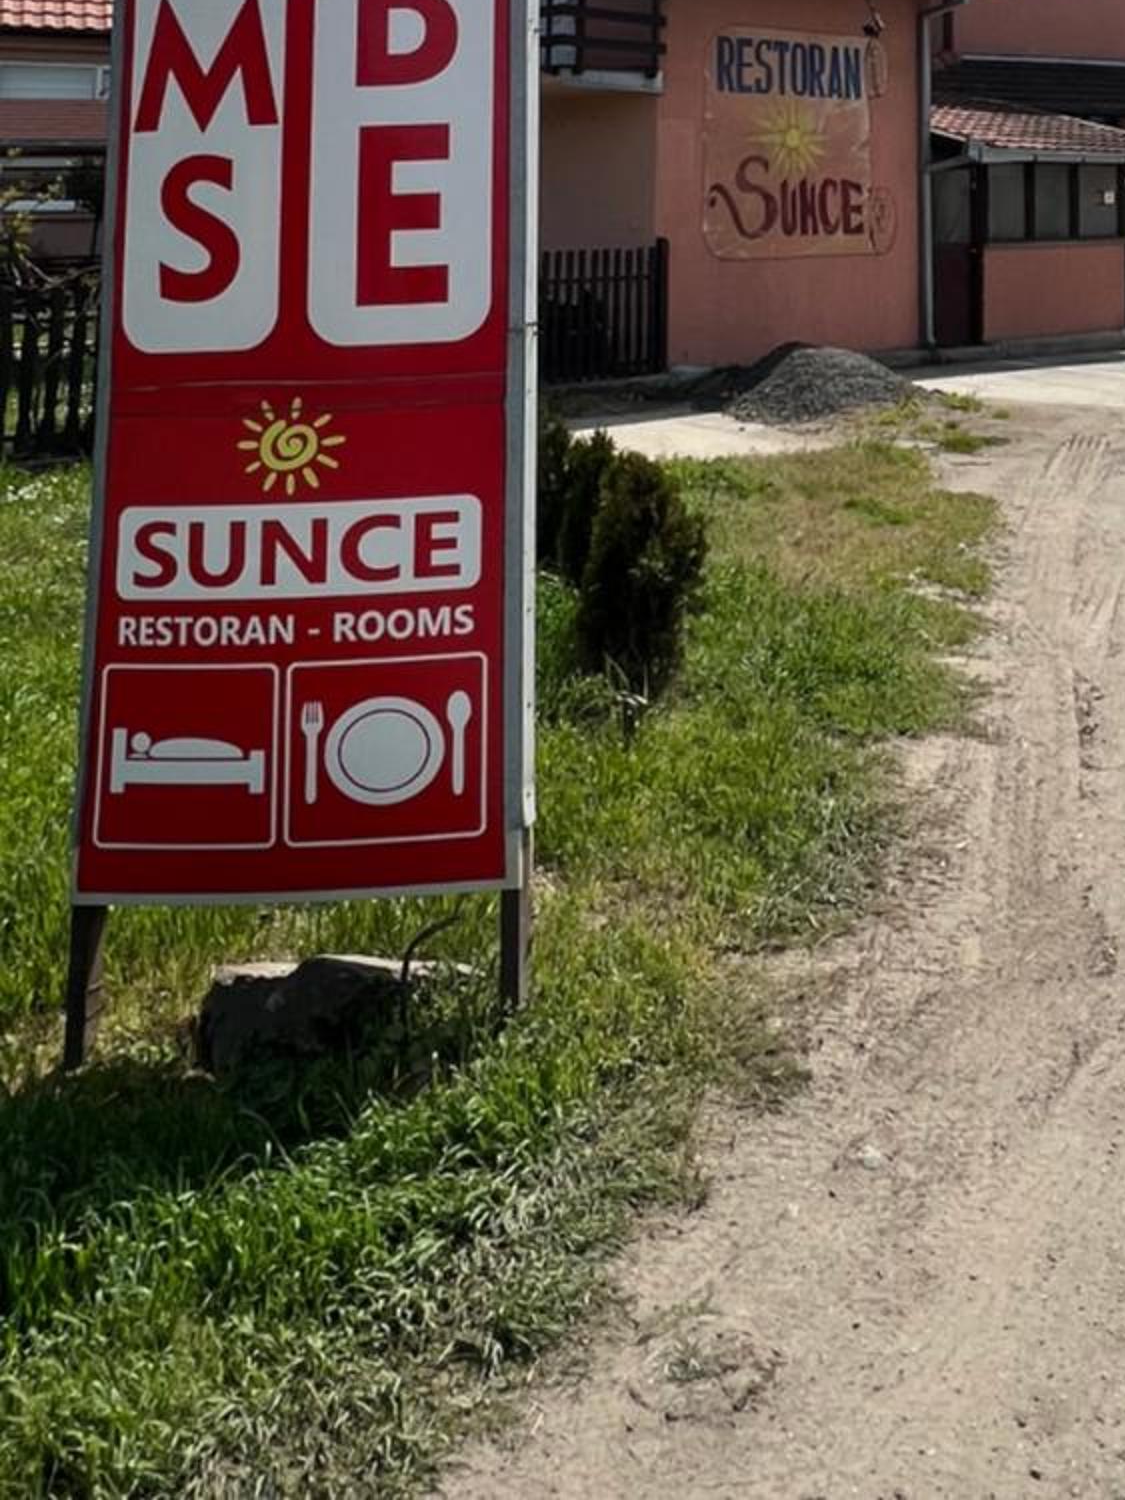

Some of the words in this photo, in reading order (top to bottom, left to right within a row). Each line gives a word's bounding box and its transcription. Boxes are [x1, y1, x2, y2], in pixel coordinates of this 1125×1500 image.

[716, 35, 863, 102] RESTORAN
[132, 510, 462, 589] SUNCE
[117, 613, 296, 647] RESTORAN
[332, 605, 475, 643] ROOMS
